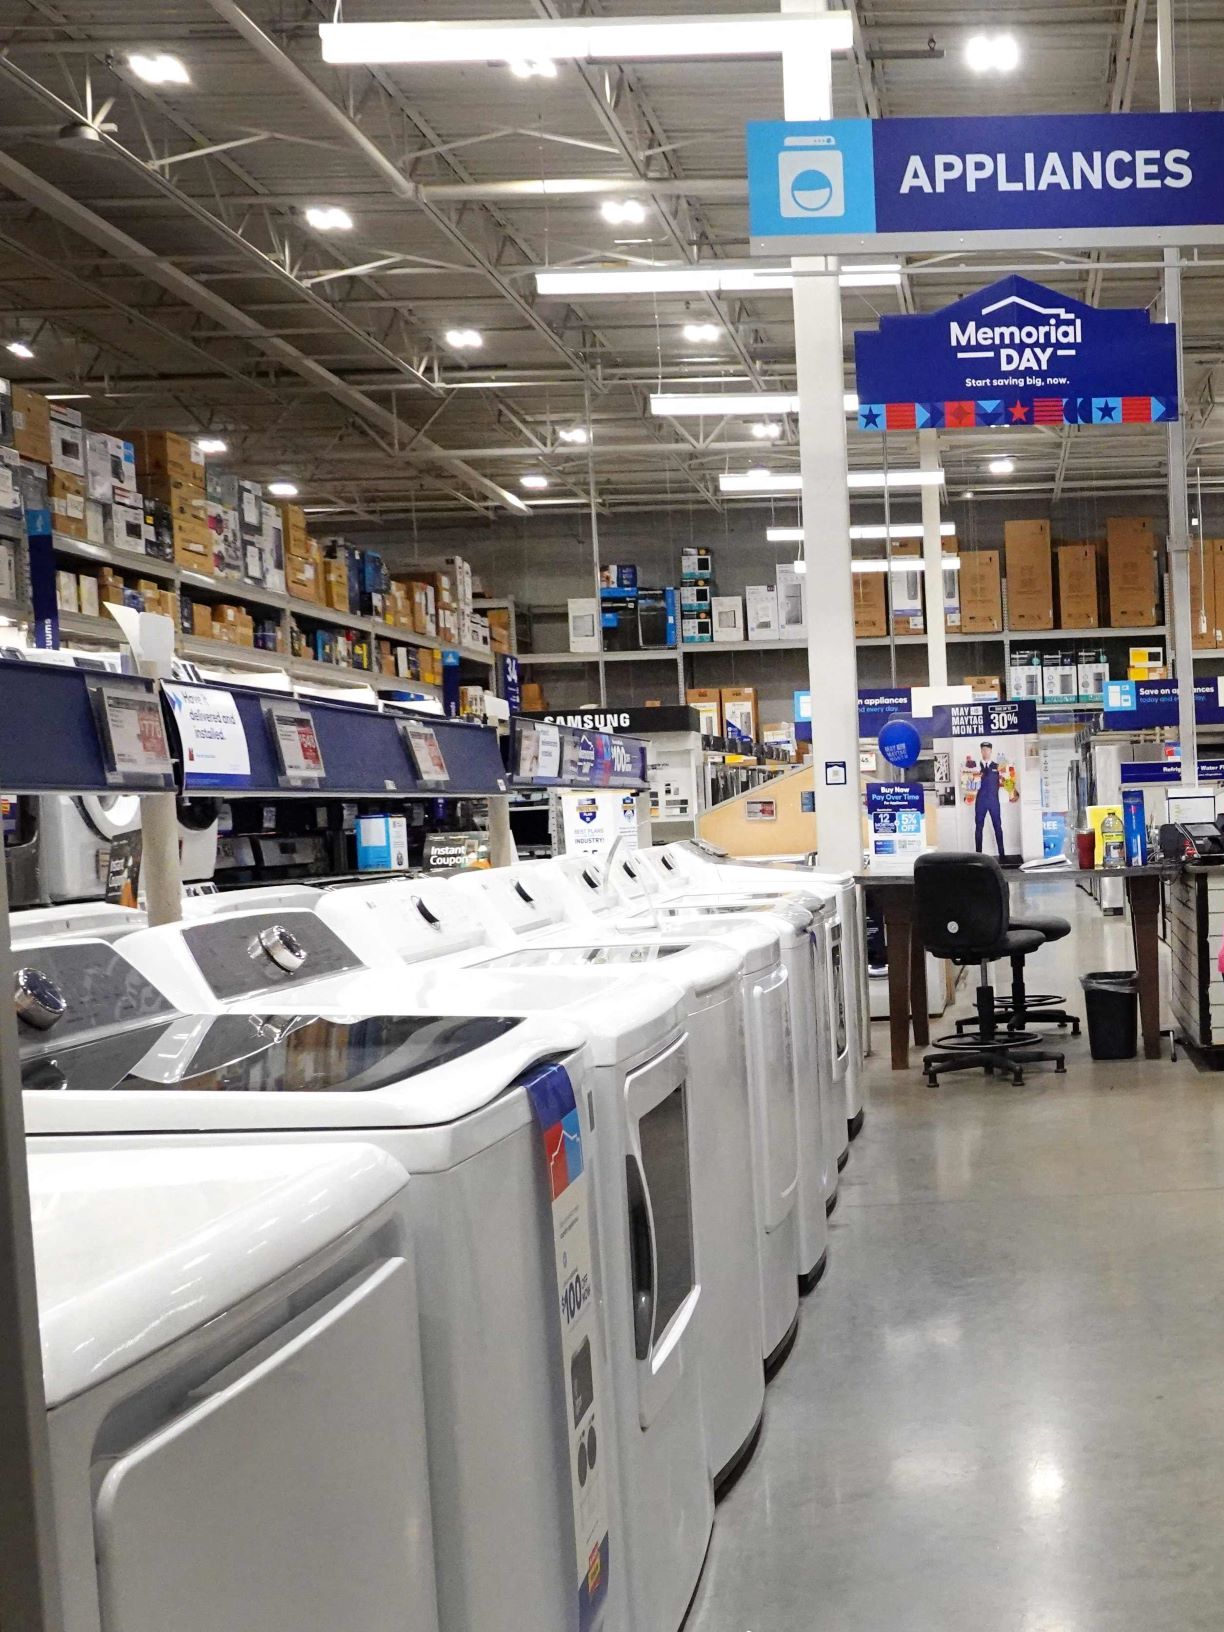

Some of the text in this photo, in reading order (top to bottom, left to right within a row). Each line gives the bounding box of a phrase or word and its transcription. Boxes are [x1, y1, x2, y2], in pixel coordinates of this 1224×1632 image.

[900, 148, 1193, 195] APPLIANCES
[949, 317, 1082, 346] Memorial
[1000, 347, 1056, 371] DAY
[965, 376, 1070, 388] Start saving big, now.
[505, 657, 518, 684] 34
[1139, 688, 1158, 696] Save
[1160, 688, 1171, 696] on
[858, 696, 908, 706] n appliances
[1140, 696, 1159, 704] today
[951, 706, 970, 716] MAY
[188, 708, 237, 725] delivered and
[952, 716, 984, 726] MAYTAG
[990, 712, 1018, 730] 30%
[194, 727, 226, 740] installed.
[952, 724, 984, 735] MONTH
[880, 786, 894, 794] Buy
[878, 814, 890, 823] 12
[1044, 820, 1058, 830] REE
[430, 846, 466, 855] Instant
[430, 856, 469, 866] Coupon
